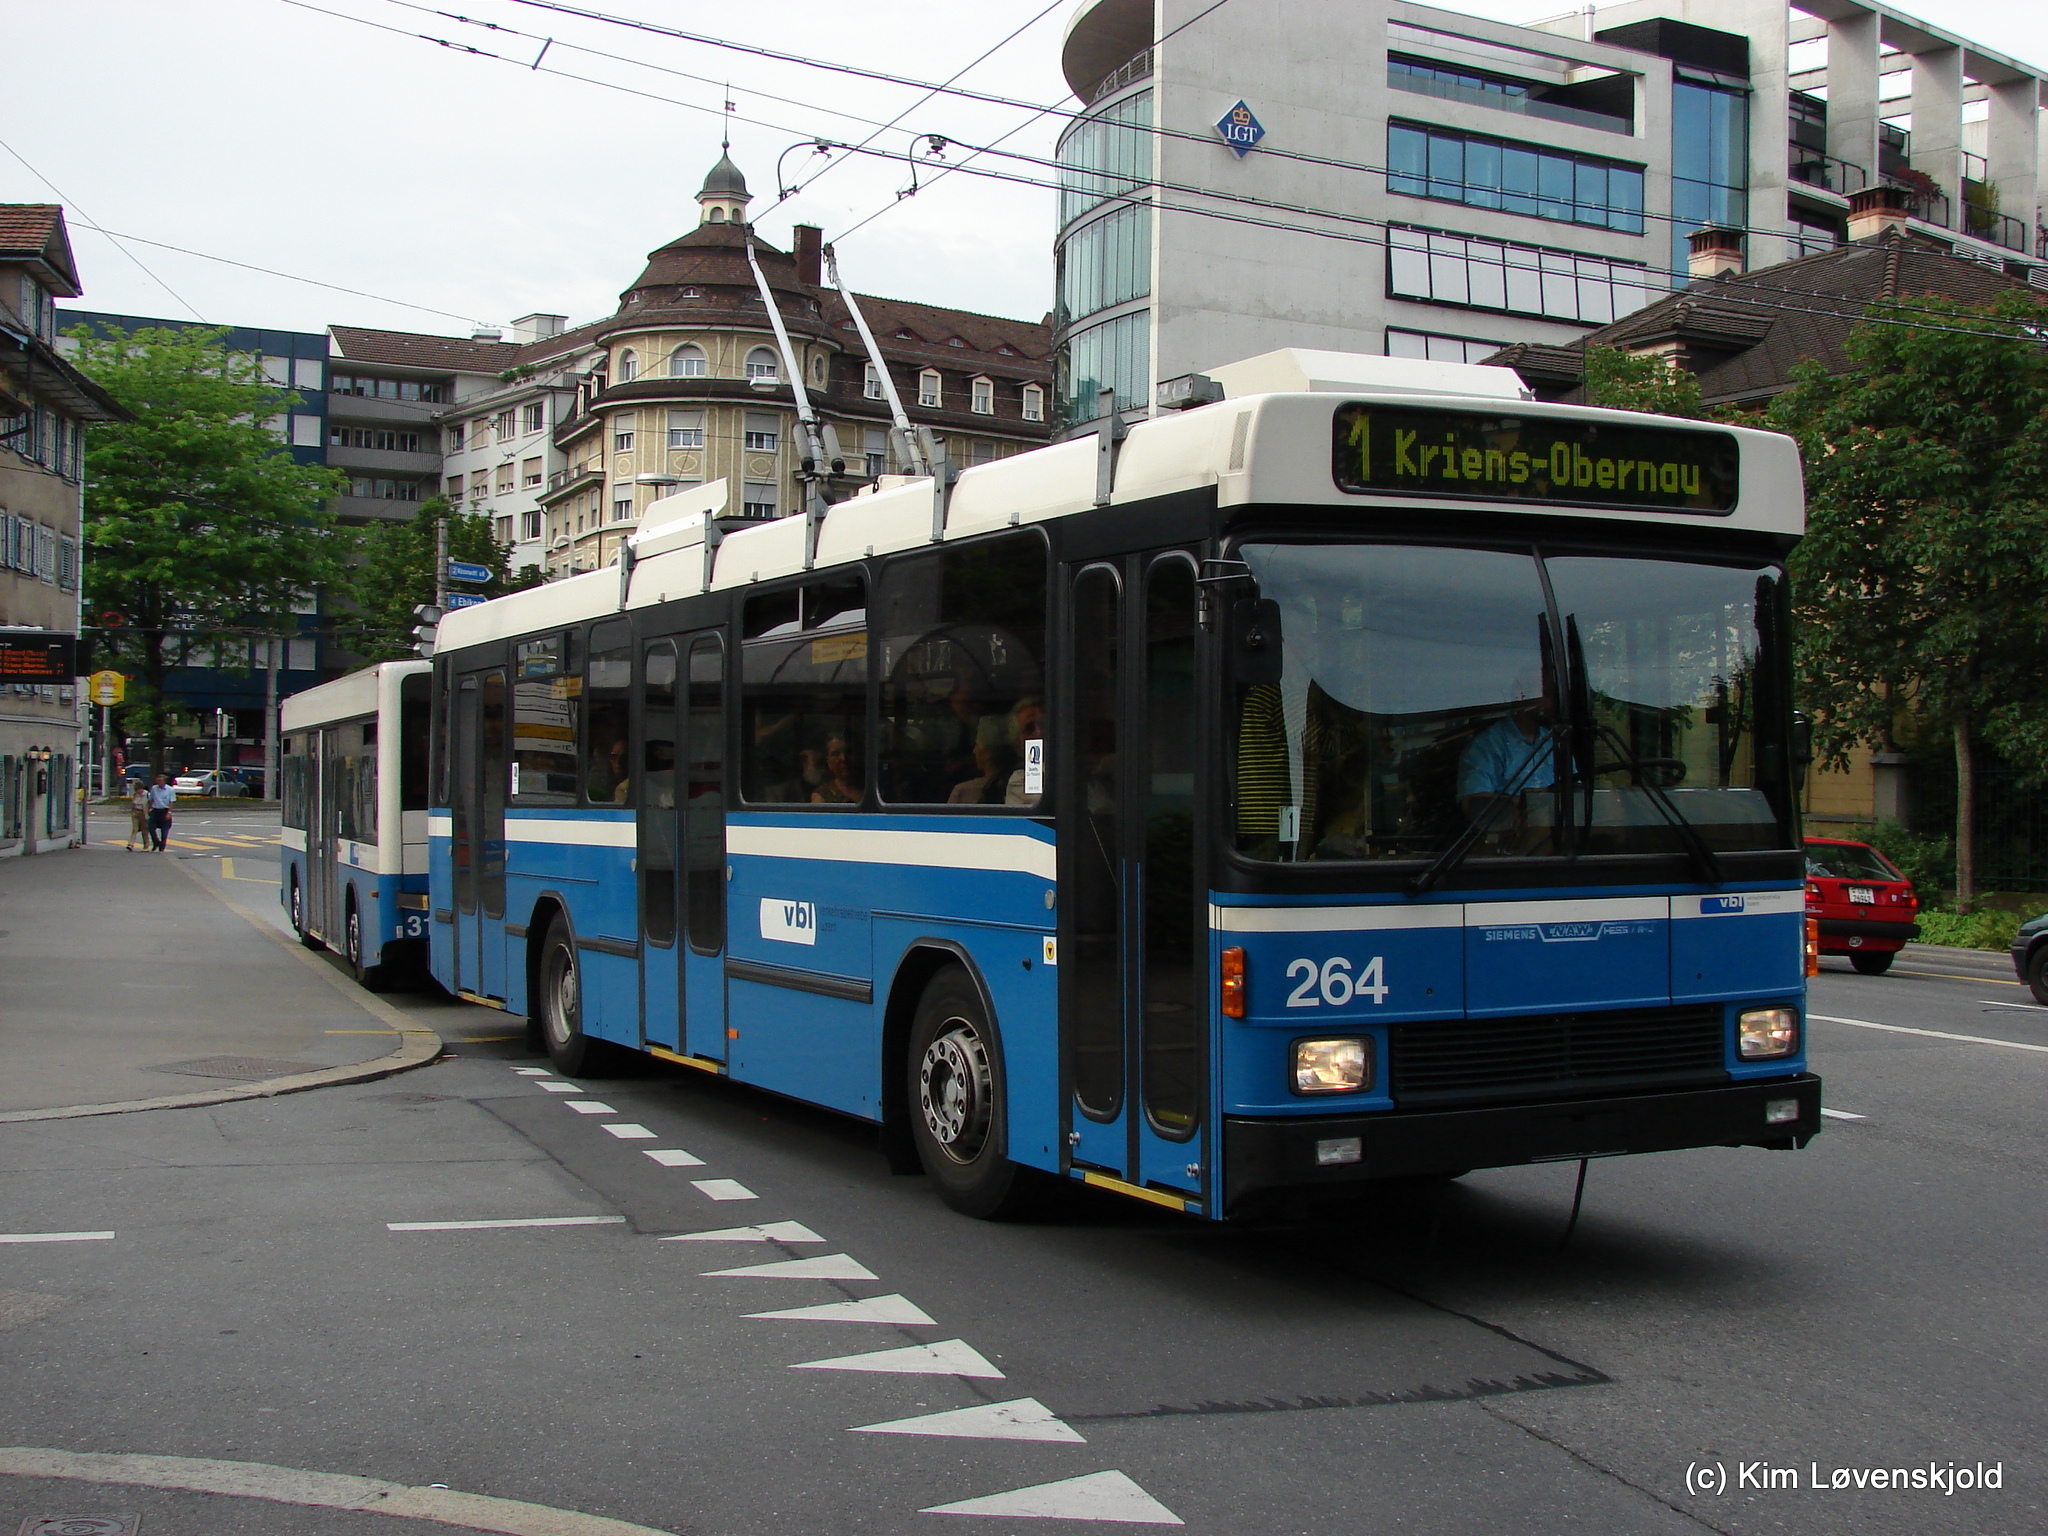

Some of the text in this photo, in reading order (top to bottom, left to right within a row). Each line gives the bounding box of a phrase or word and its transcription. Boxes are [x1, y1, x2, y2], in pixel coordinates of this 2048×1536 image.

[1227, 123, 1257, 143] LGT
[1348, 415, 1700, 495] 1 Kriens-Obernau
[1720, 896, 1743, 908] vbl
[784, 901, 813, 930] vbl
[1485, 928, 1536, 941] SIEMENS
[1551, 923, 1592, 938] NAW
[1286, 956, 1389, 1007] 264
